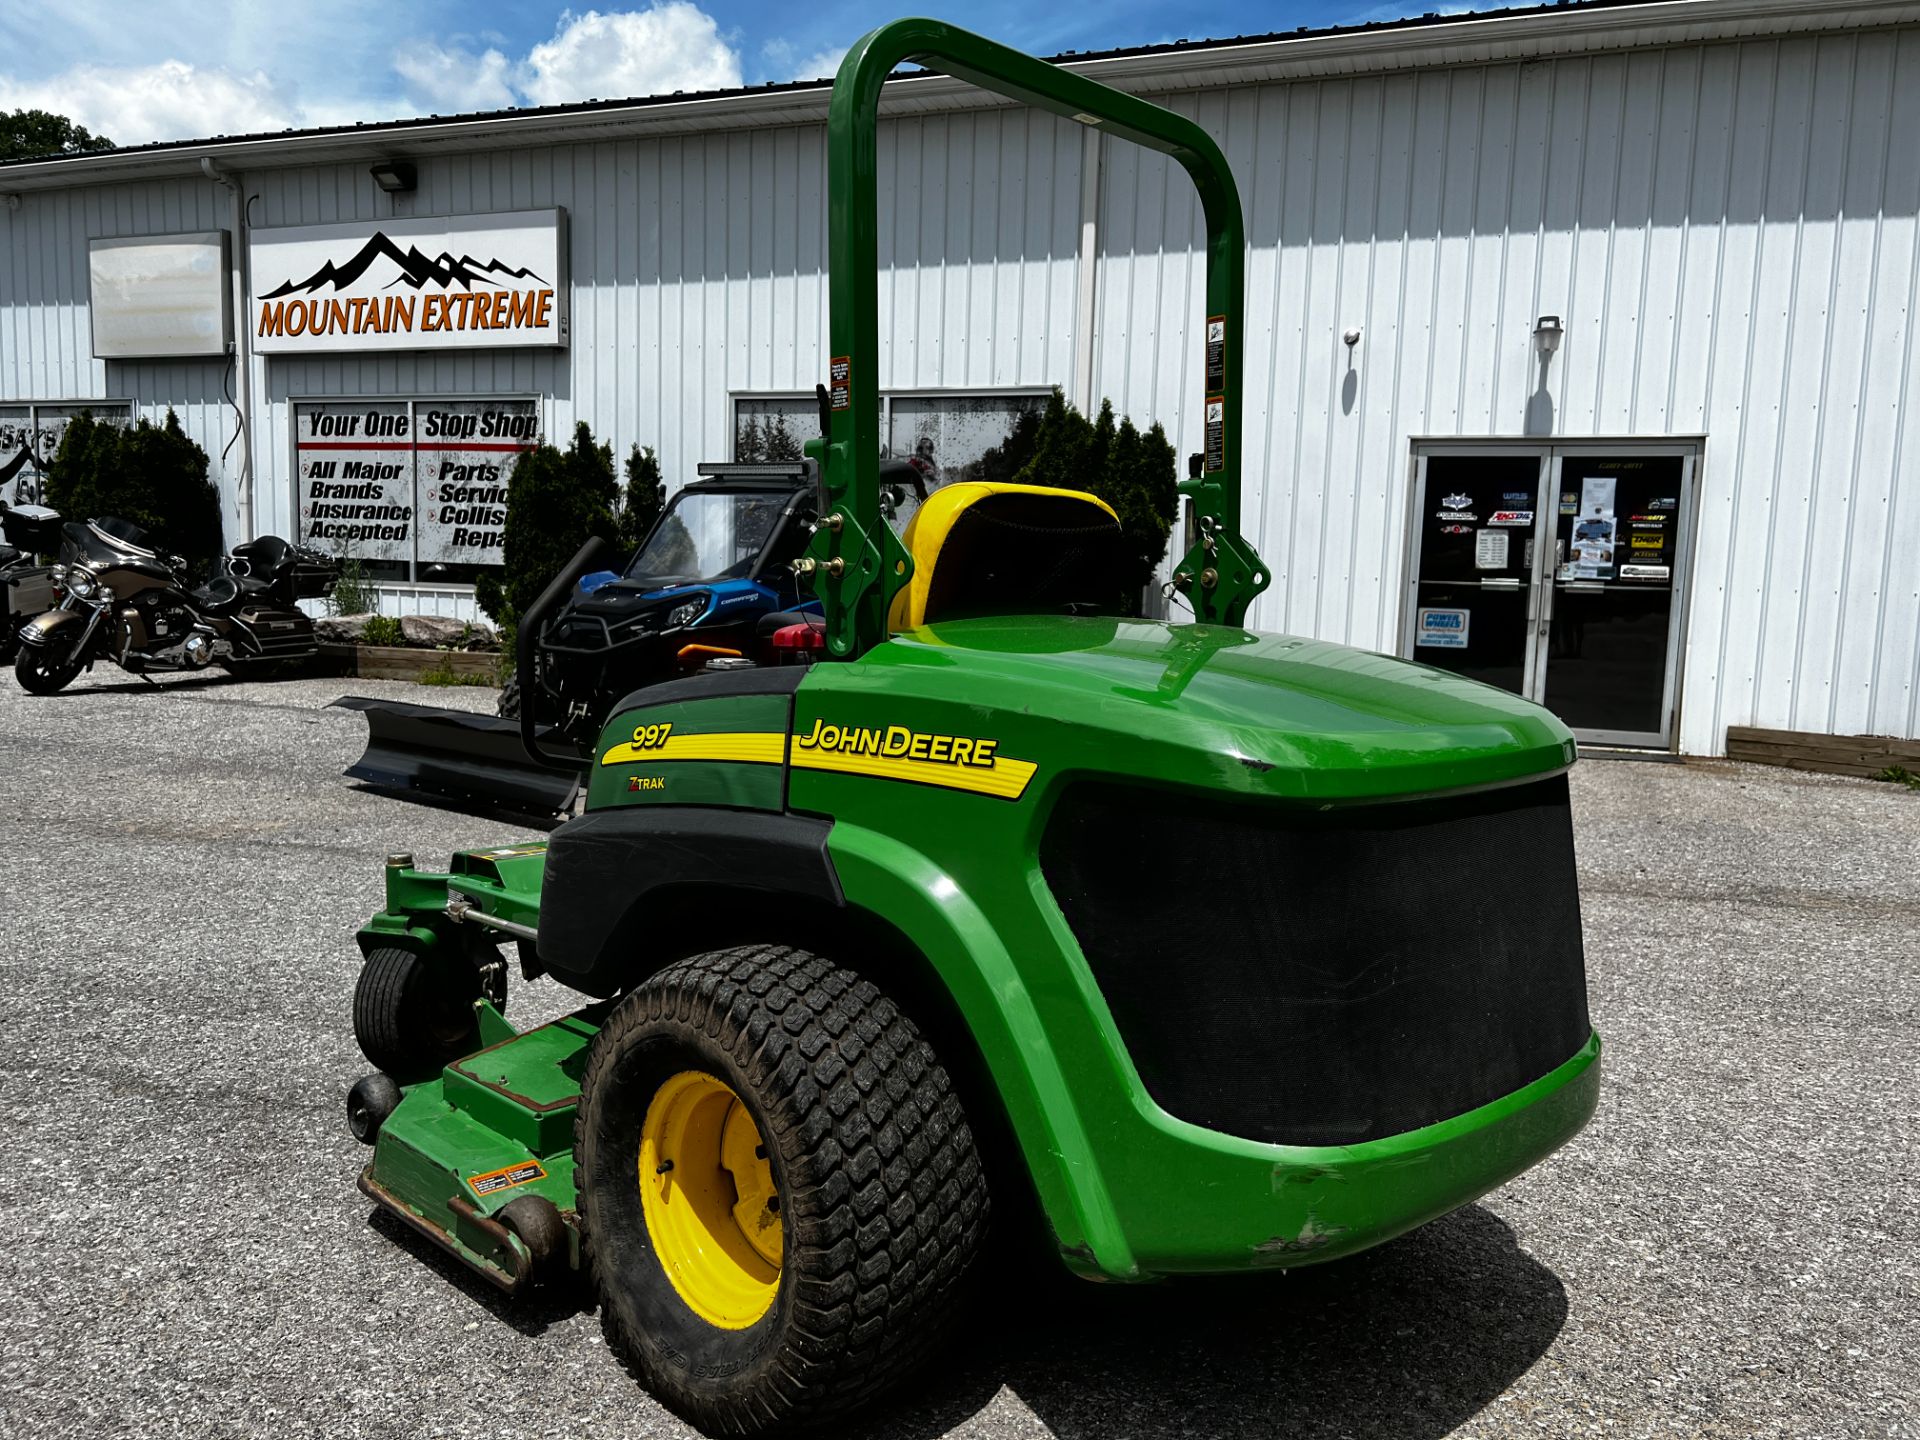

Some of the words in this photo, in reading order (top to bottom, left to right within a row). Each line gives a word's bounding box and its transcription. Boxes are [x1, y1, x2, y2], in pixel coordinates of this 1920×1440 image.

[258, 294, 416, 337] MOUNTAIN
[420, 288, 554, 332] EXTREME
[310, 411, 360, 437] Your
[364, 411, 408, 437] One
[426, 410, 477, 440] Stop
[479, 411, 538, 441] Shop
[309, 462, 336, 479] All
[342, 461, 404, 481] Major
[438, 461, 500, 481] Parts
[310, 482, 384, 500] Brands
[310, 501, 412, 521] Insurance
[309, 521, 408, 542] Accepted
[631, 722, 674, 751] 997
[799, 718, 884, 754] JOHN
[880, 725, 998, 768] DEERE
